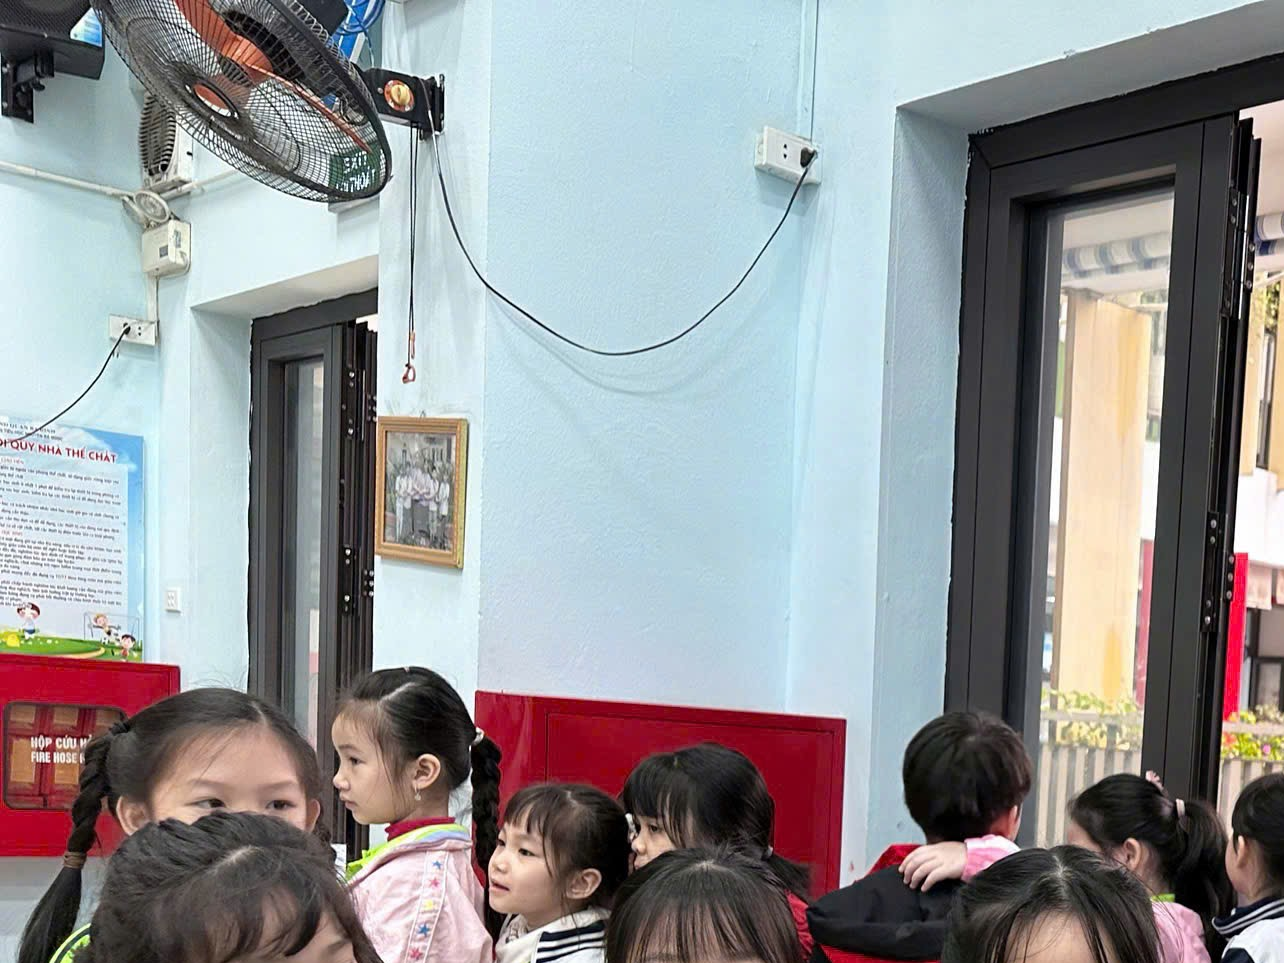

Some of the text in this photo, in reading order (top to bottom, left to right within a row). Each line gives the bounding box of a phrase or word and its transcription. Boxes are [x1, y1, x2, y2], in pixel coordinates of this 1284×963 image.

[10, 439, 35, 452] QUY
[30, 734, 52, 750] HỘP
[31, 751, 51, 763] FIRE
[53, 751, 77, 764] HOSE
